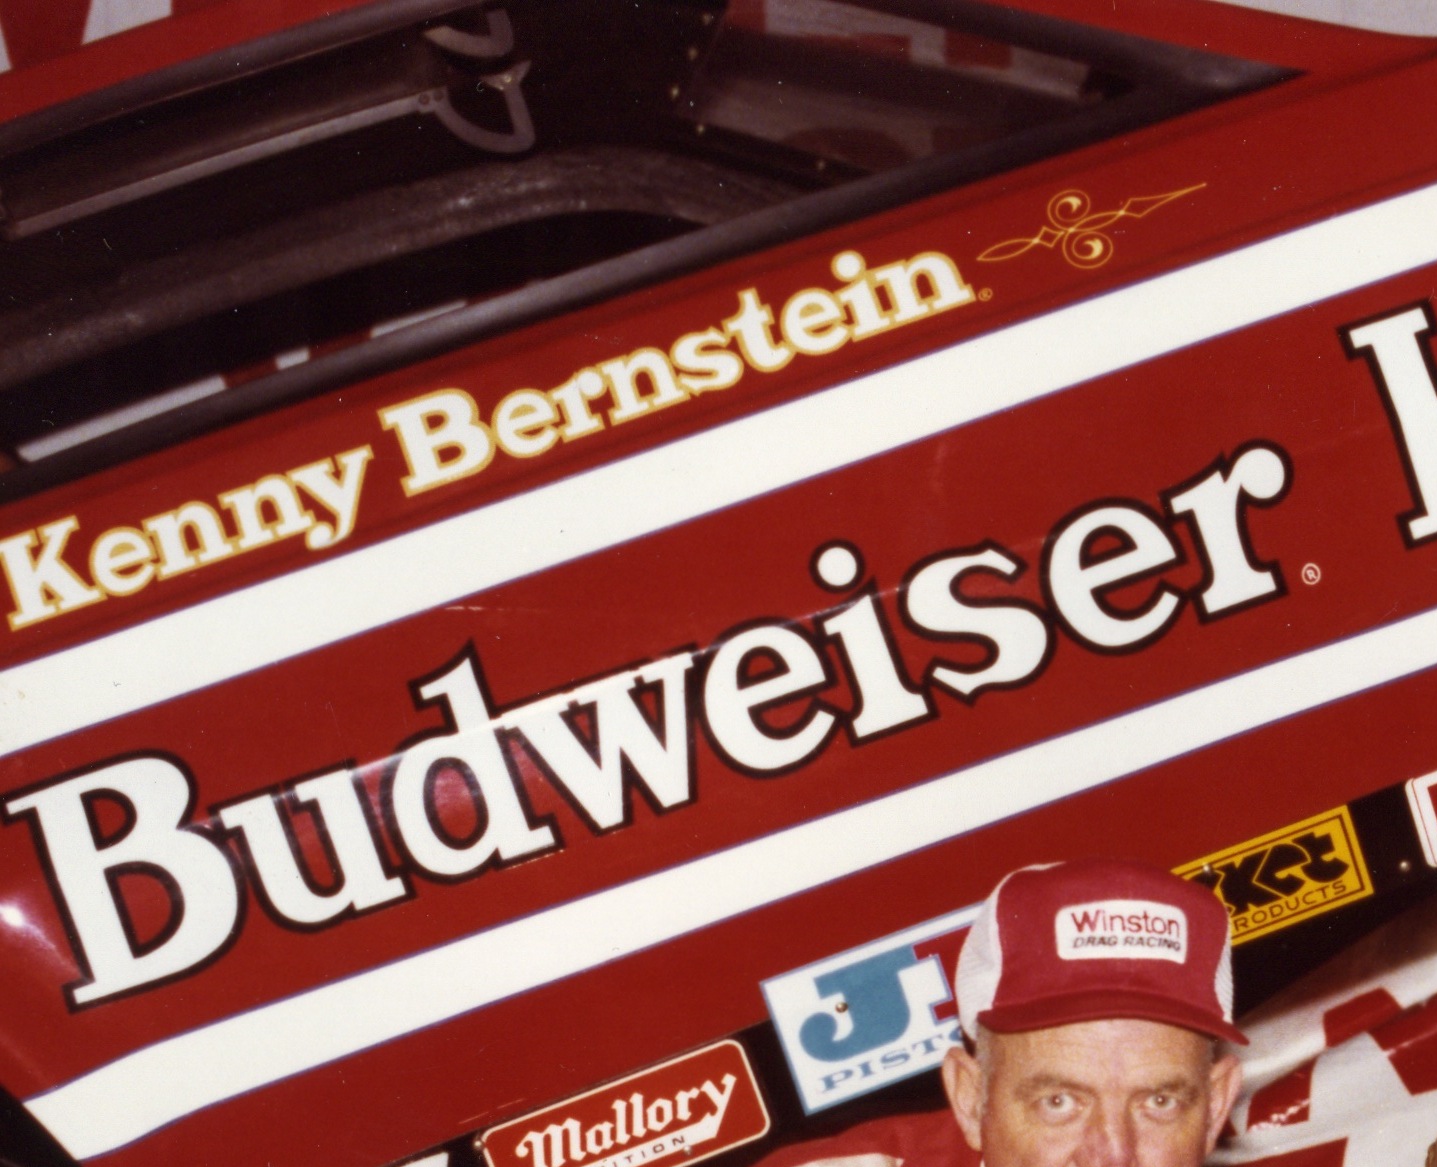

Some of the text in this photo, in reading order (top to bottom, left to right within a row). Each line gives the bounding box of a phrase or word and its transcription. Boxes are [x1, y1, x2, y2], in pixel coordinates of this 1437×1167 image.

[0, 250, 975, 630] Kenny Bernstein
[4, 440, 1292, 1009] Budweiser
[1071, 909, 1180, 938] Winston
[1233, 880, 1347, 932] RODUCTS
[1073, 935, 1181, 952] DRAG RACING
